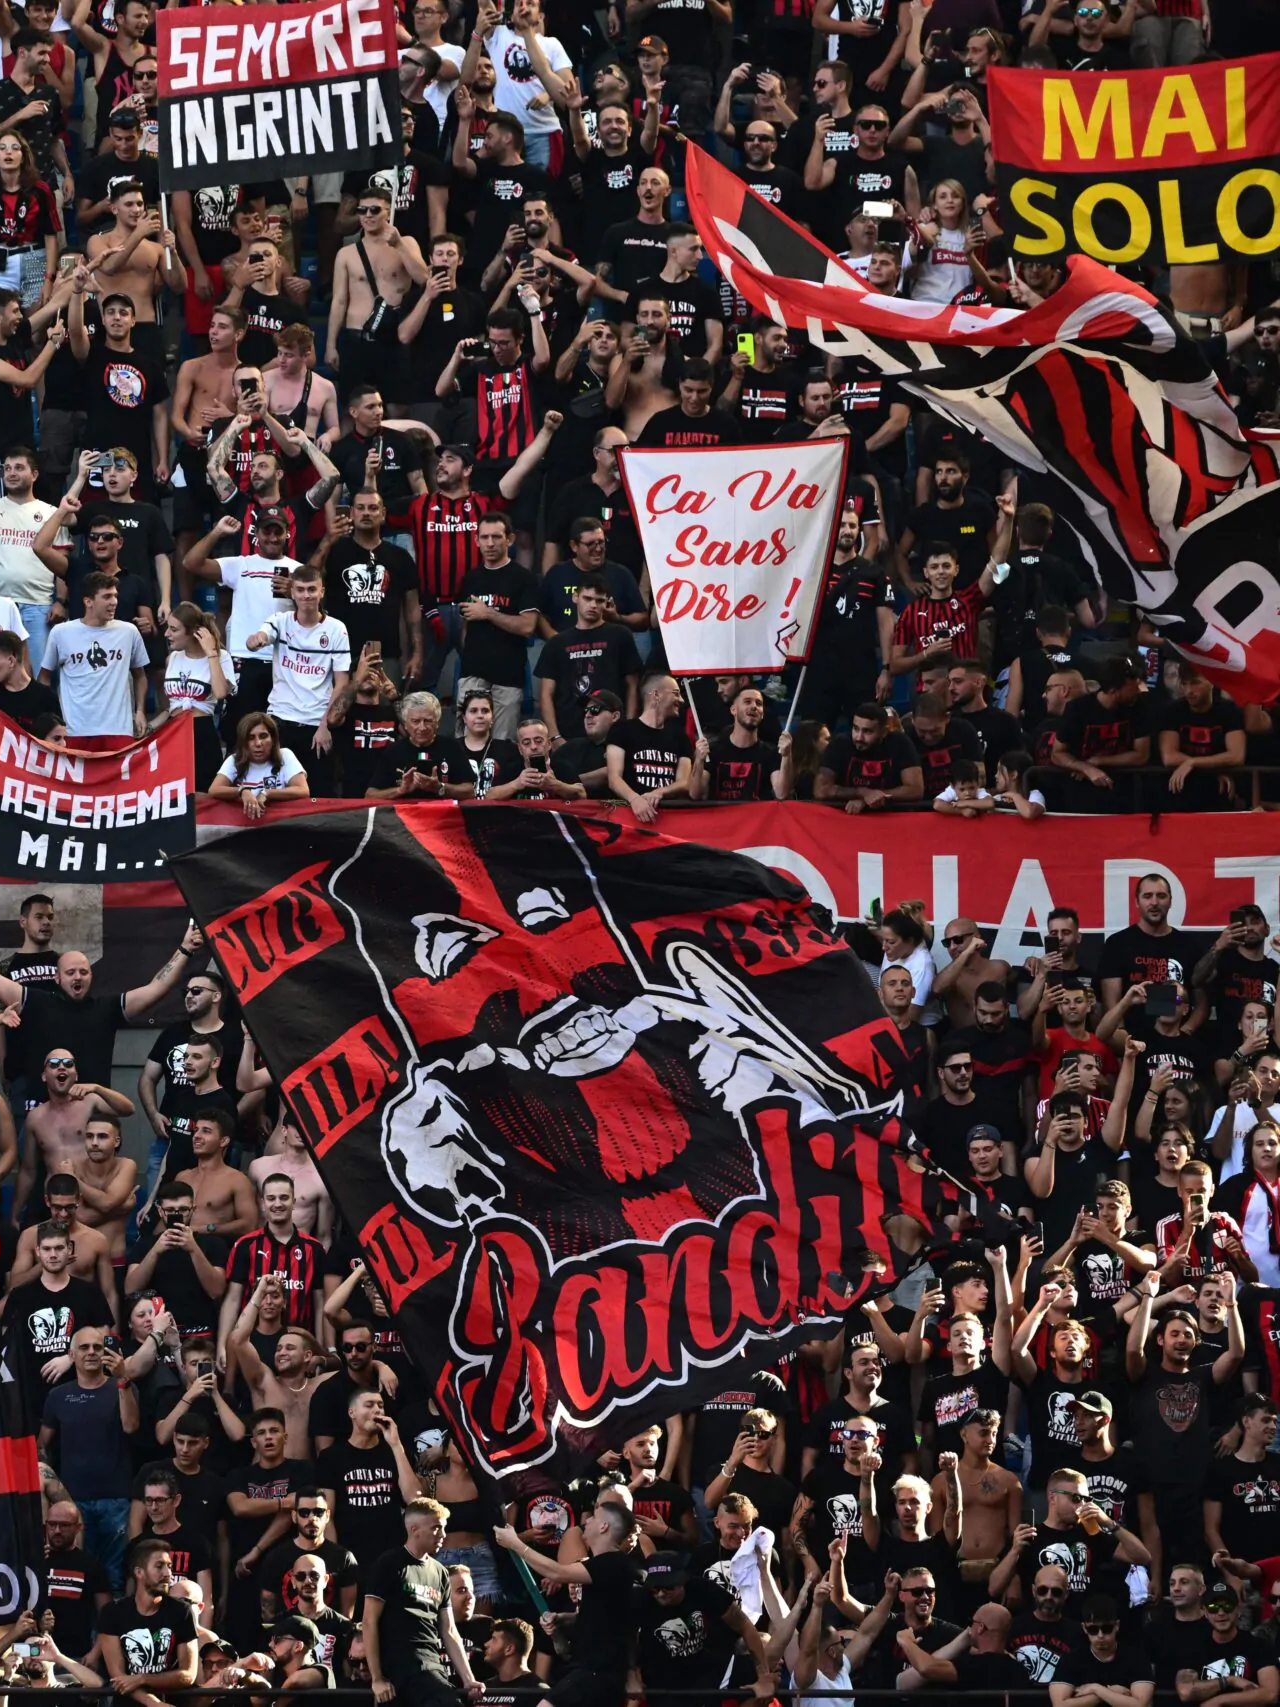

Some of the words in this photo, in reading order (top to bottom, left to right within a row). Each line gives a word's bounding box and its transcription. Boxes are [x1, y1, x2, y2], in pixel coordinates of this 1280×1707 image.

[169, 0, 386, 90] SEMPRE
[1042, 66, 1247, 161] MAI
[1009, 167, 1280, 264] SOLO
[646, 474, 716, 524] Ça
[727, 468, 827, 511] Va
[444, 514, 461, 524] Fly
[426, 521, 480, 533] Emirates
[666, 524, 796, 568] Sans
[347, 590, 386, 599] CAMPIONI
[349, 596, 382, 604] D'ITALIA
[656, 577, 767, 624] Dire
[70, 652, 83, 664] 19
[109, 649, 122, 661] 76
[295, 652, 311, 664] Fly
[569, 649, 603, 660] MILANO
[281, 655, 327, 676] Emirates
[633, 748, 661, 761] CURVA
[9, 965, 58, 982] BANDIT
[1177, 1055, 1195, 1069] SUD
[271, 1269, 289, 1283] Fly
[1088, 1280, 1131, 1292] CAMPIONI
[1091, 1287, 1127, 1300] D'ITALIA
[31, 1336, 71, 1346] CAMPIONI
[851, 1331, 876, 1348] CURV
[34, 1342, 67, 1353] D'ITALIA
[343, 1469, 372, 1482] CURVA
[373, 1467, 392, 1480] SUD
[347, 1482, 392, 1495] BANDITI
[348, 1494, 391, 1507] MILANO
